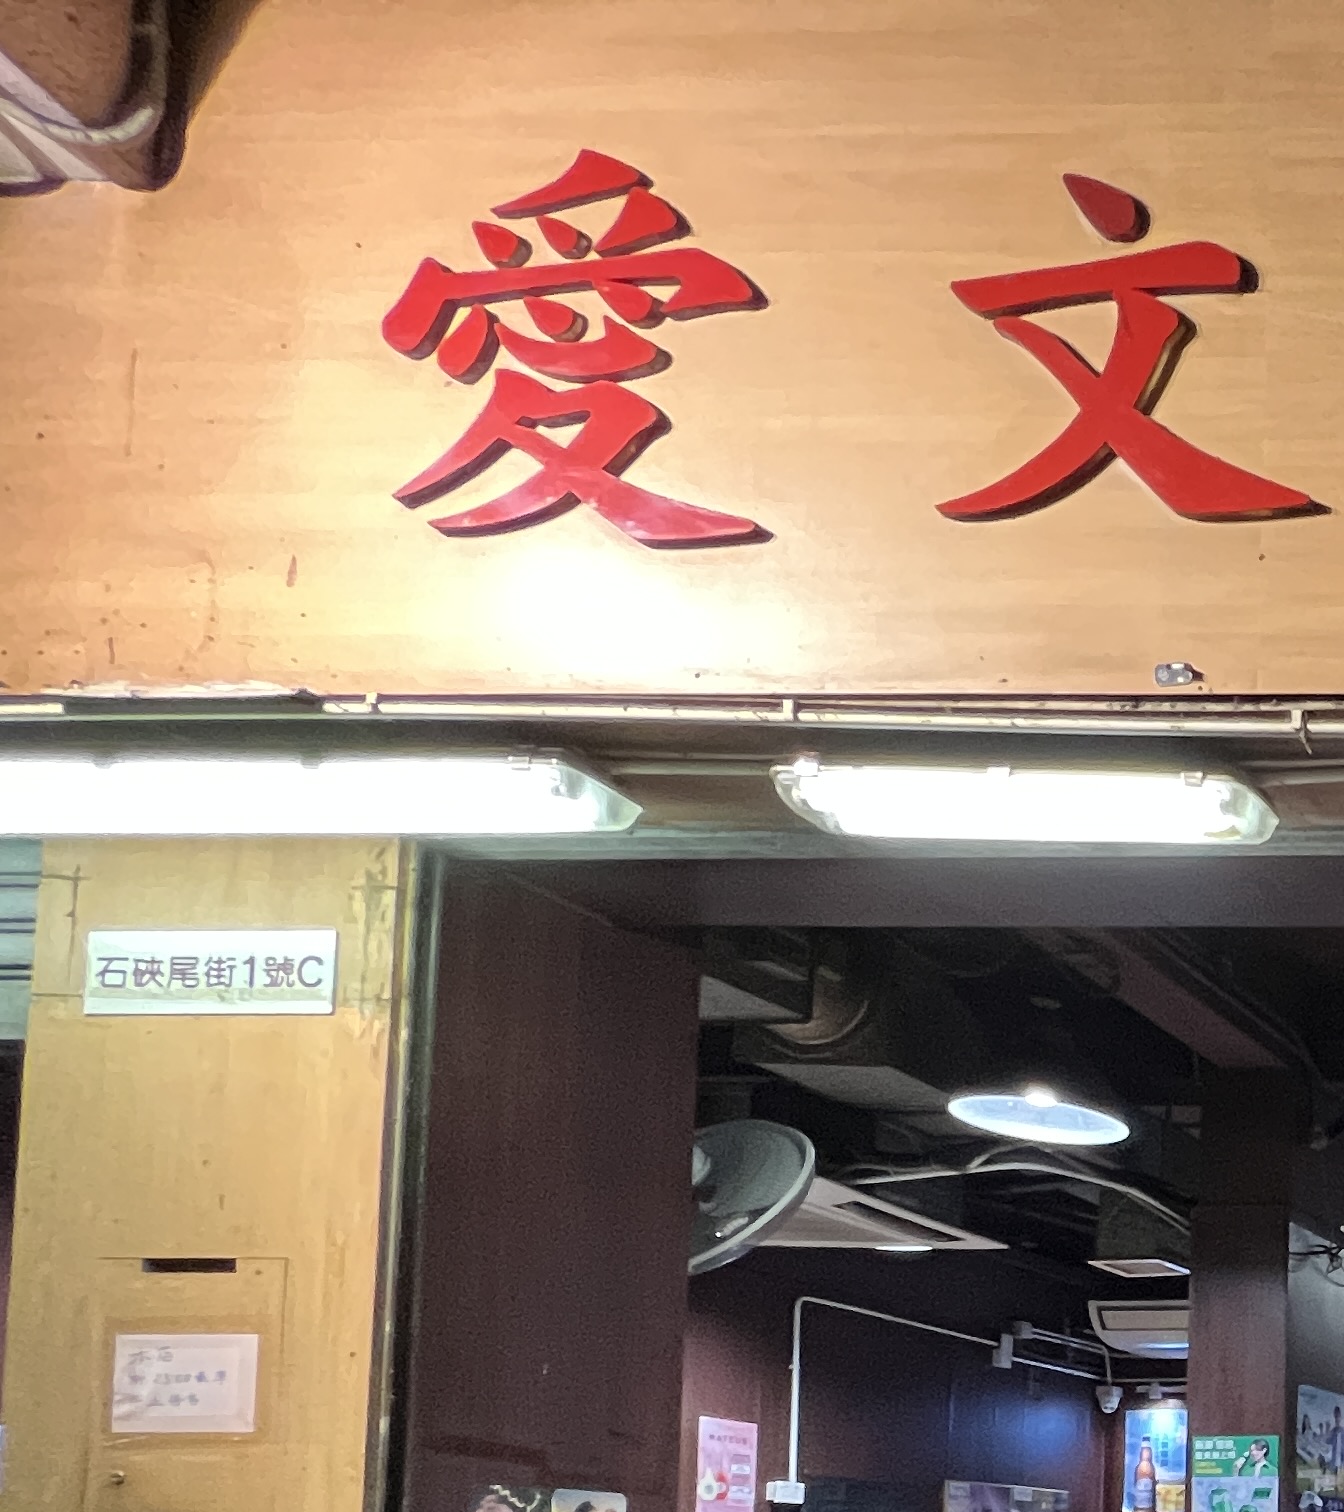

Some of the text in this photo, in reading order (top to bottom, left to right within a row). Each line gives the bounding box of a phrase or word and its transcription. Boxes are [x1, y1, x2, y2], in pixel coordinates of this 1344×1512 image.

[96, 956, 324, 989] 石硤尾街1號C
